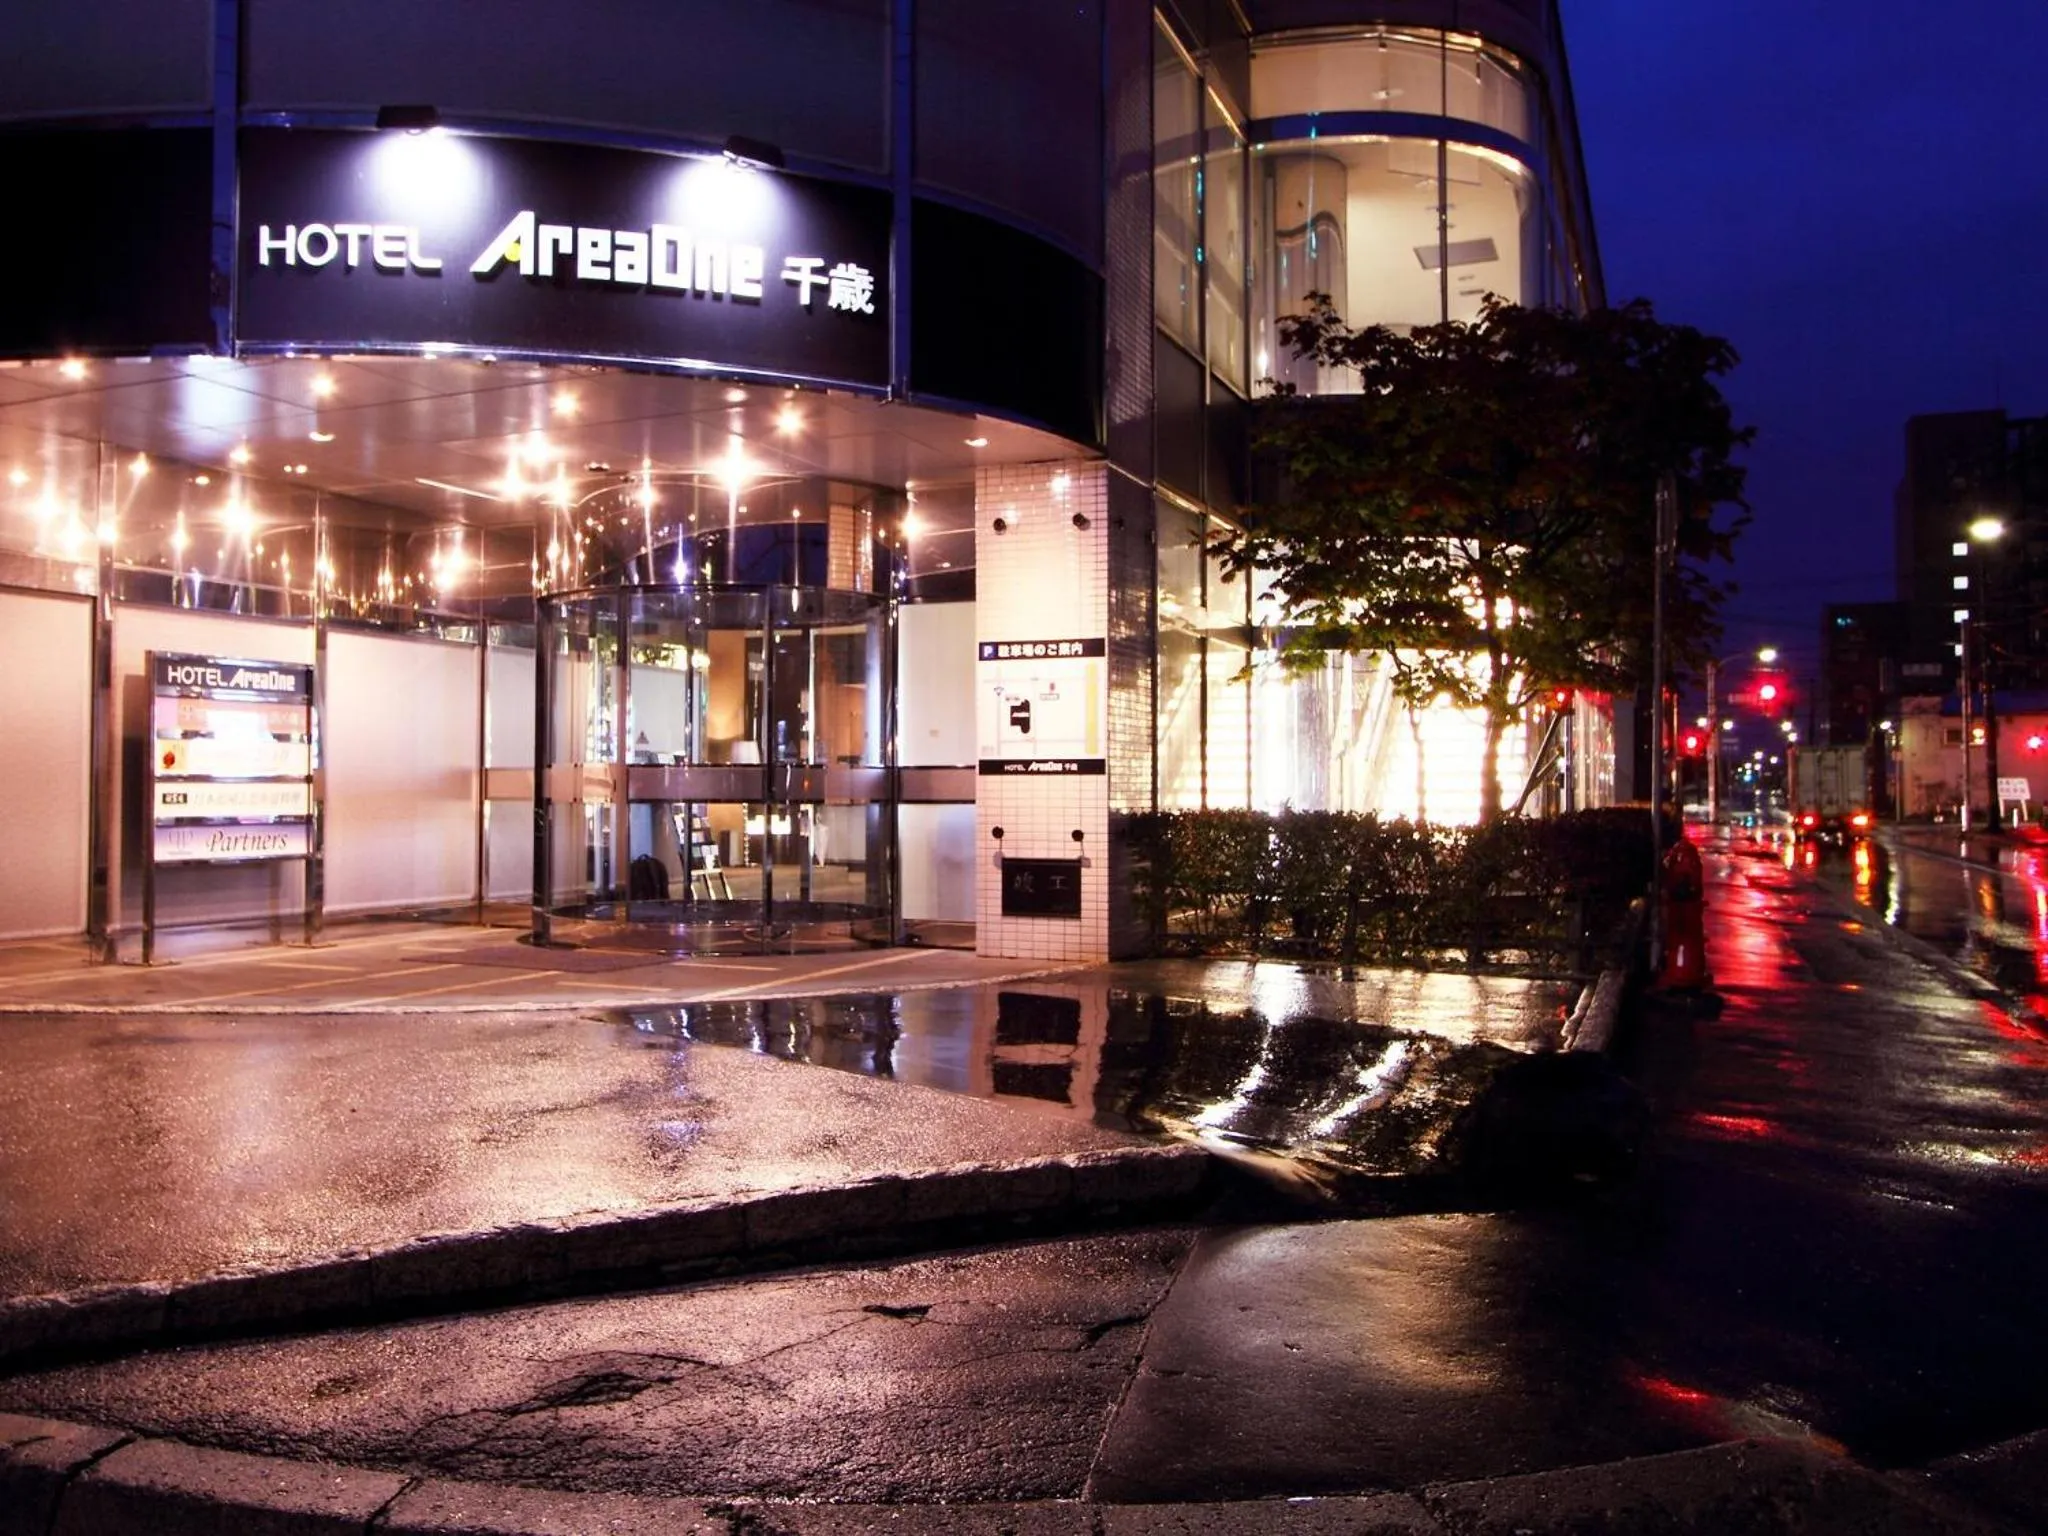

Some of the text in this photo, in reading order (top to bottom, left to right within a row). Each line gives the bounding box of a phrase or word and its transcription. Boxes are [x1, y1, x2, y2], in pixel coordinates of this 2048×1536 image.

[258, 210, 875, 315] HOTEL AreaOne 千歳
[983, 645, 995, 658] P
[167, 665, 296, 692] HOTEL AreaOne
[206, 829, 289, 853] Partners
